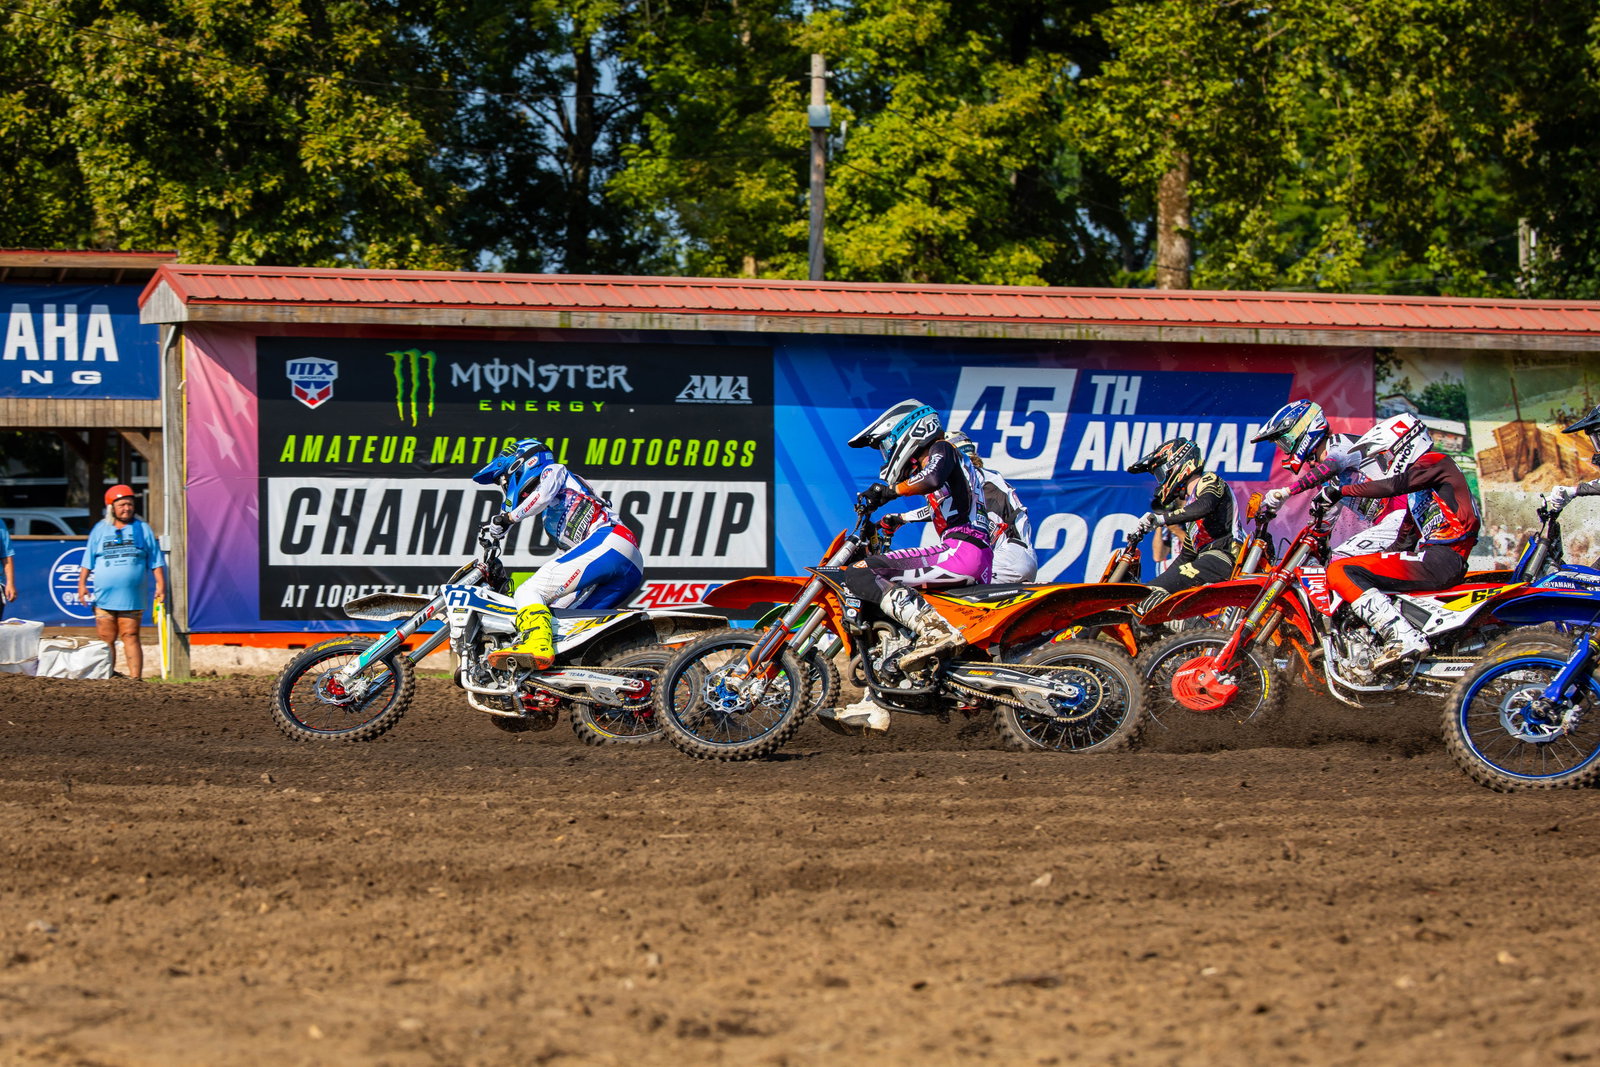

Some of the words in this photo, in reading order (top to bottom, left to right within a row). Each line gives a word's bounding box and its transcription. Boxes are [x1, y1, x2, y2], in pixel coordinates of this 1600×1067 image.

[3, 303, 119, 362] AHA
[289, 362, 336, 376] MX
[450, 357, 634, 394] MONSTER
[675, 375, 752, 400] AMA
[1091, 375, 1142, 415] TH
[479, 400, 605, 412] ENERGY
[959, 386, 1055, 460] 45
[279, 434, 417, 463] AMATEUR
[584, 438, 757, 467] MOTOCROSS
[1169, 443, 1191, 466] OAKLEY
[1298, 434, 1312, 455] THOR
[281, 585, 309, 608] AT
[1550, 581, 1576, 590] YAMAHA
